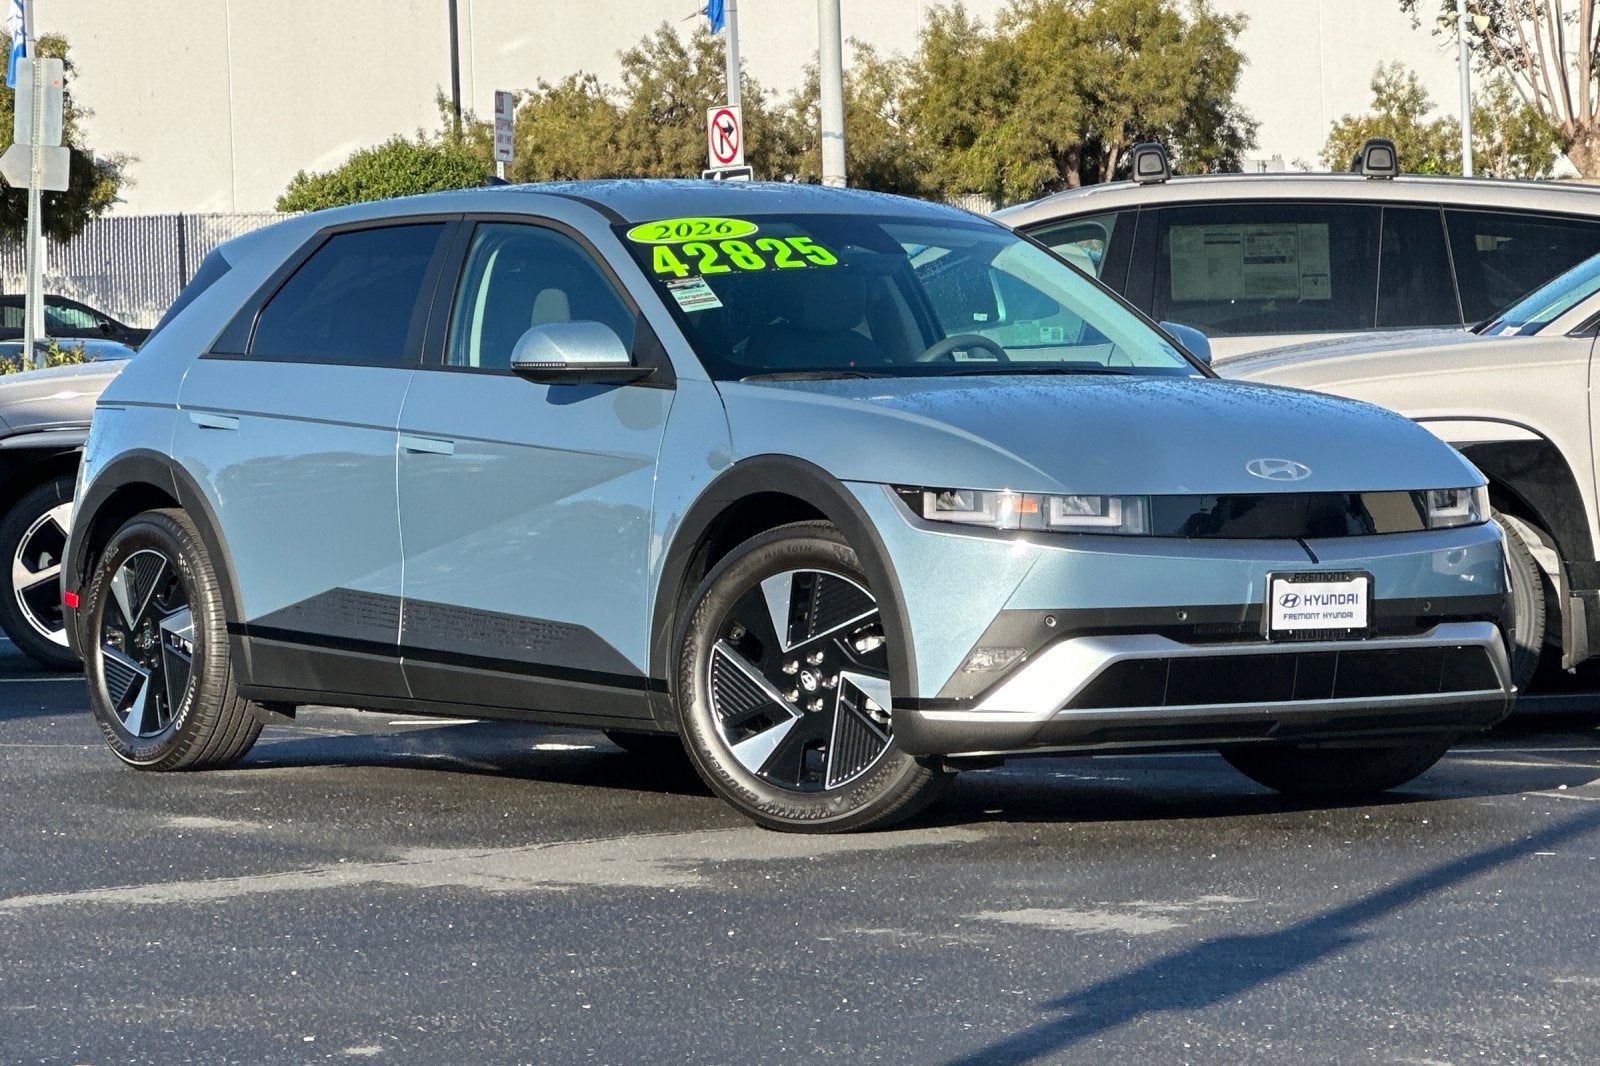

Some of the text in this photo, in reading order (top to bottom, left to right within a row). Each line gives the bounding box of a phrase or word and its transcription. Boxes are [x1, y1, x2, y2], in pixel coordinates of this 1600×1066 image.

[655, 220, 733, 240] 2026
[653, 237, 838, 277] 42825
[1304, 593, 1359, 606] HYUNDAI
[1283, 611, 1354, 620] FREMONT HYUNDAI
[175, 675, 197, 731] KUMHO
